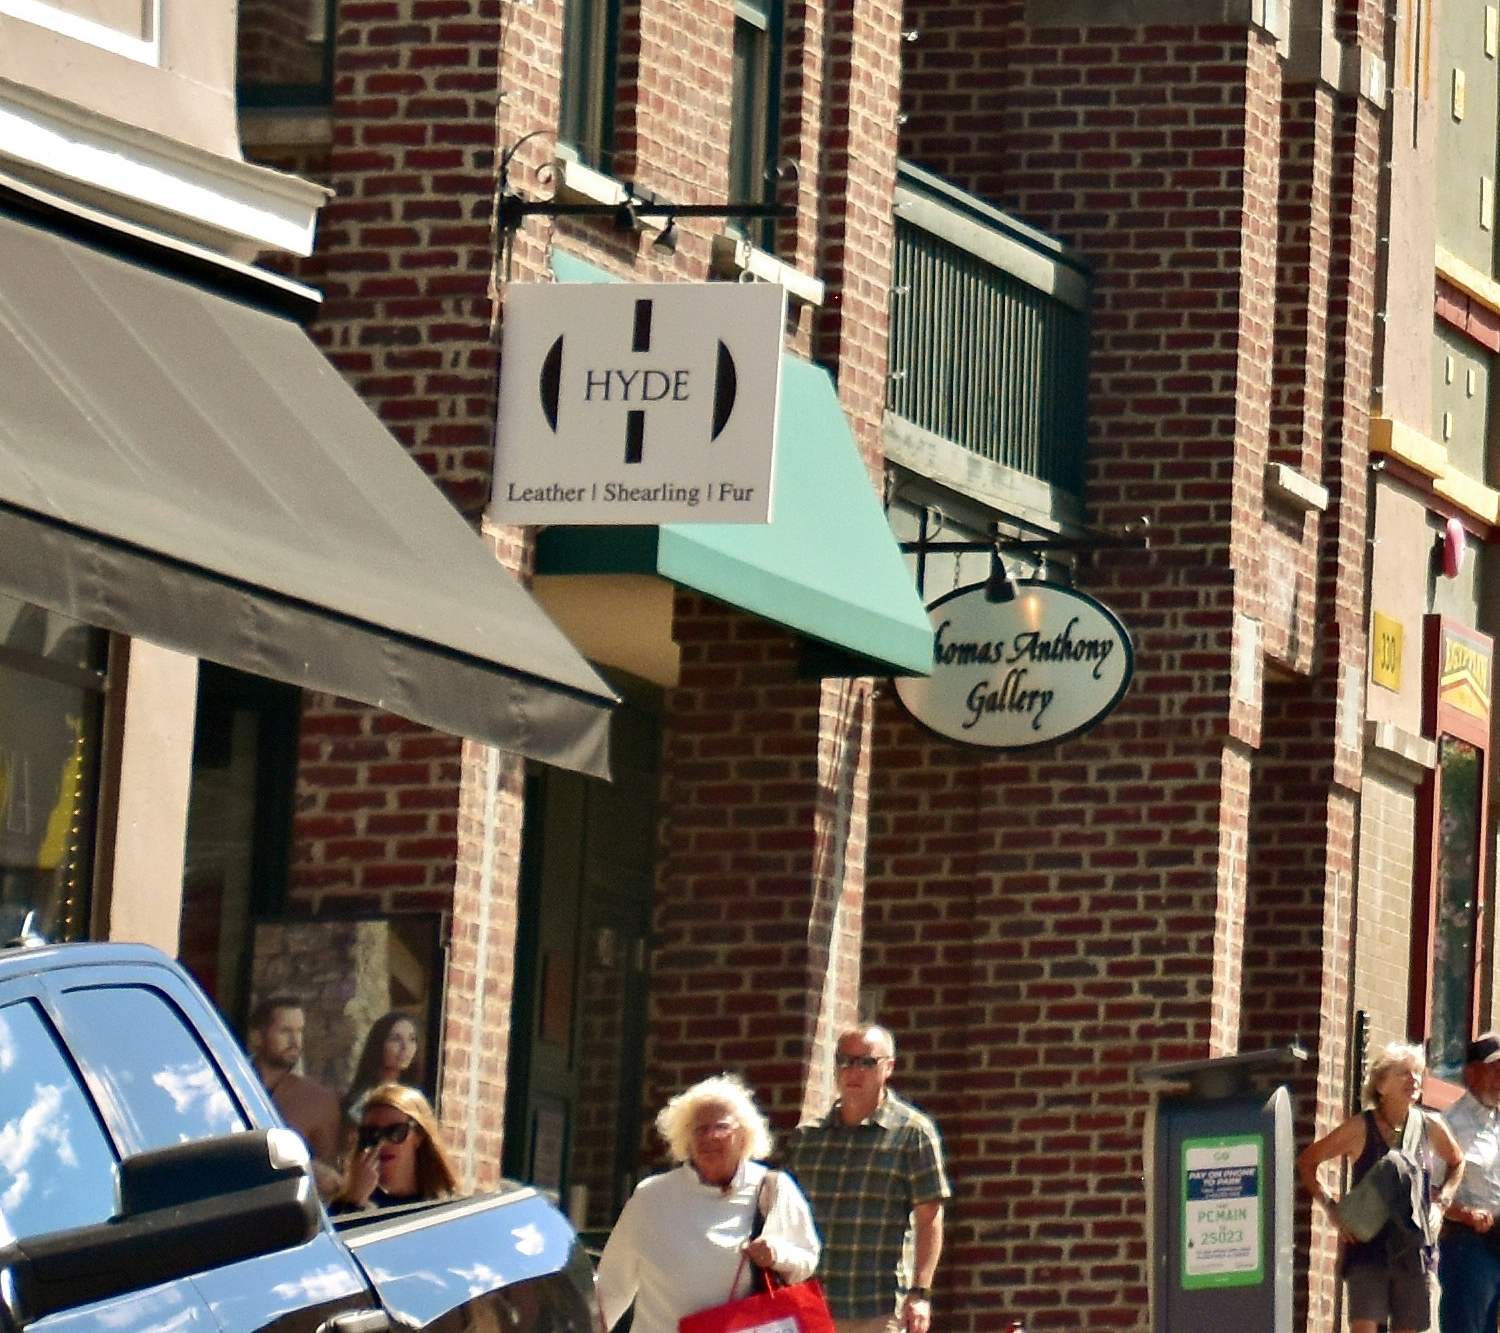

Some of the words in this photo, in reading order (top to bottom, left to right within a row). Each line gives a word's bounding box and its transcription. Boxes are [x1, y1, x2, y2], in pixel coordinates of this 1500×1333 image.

[584, 370, 690, 401] HYDE
[507, 483, 585, 502] Leather
[603, 484, 700, 506] Shearling
[718, 484, 754, 502] Fur
[934, 620, 1004, 665] homas
[1006, 617, 1114, 680] Anthony
[962, 668, 1054, 731] Gallery
[1197, 1209, 1248, 1223] PCMAIN
[1200, 1231, 1244, 1246] 25023
